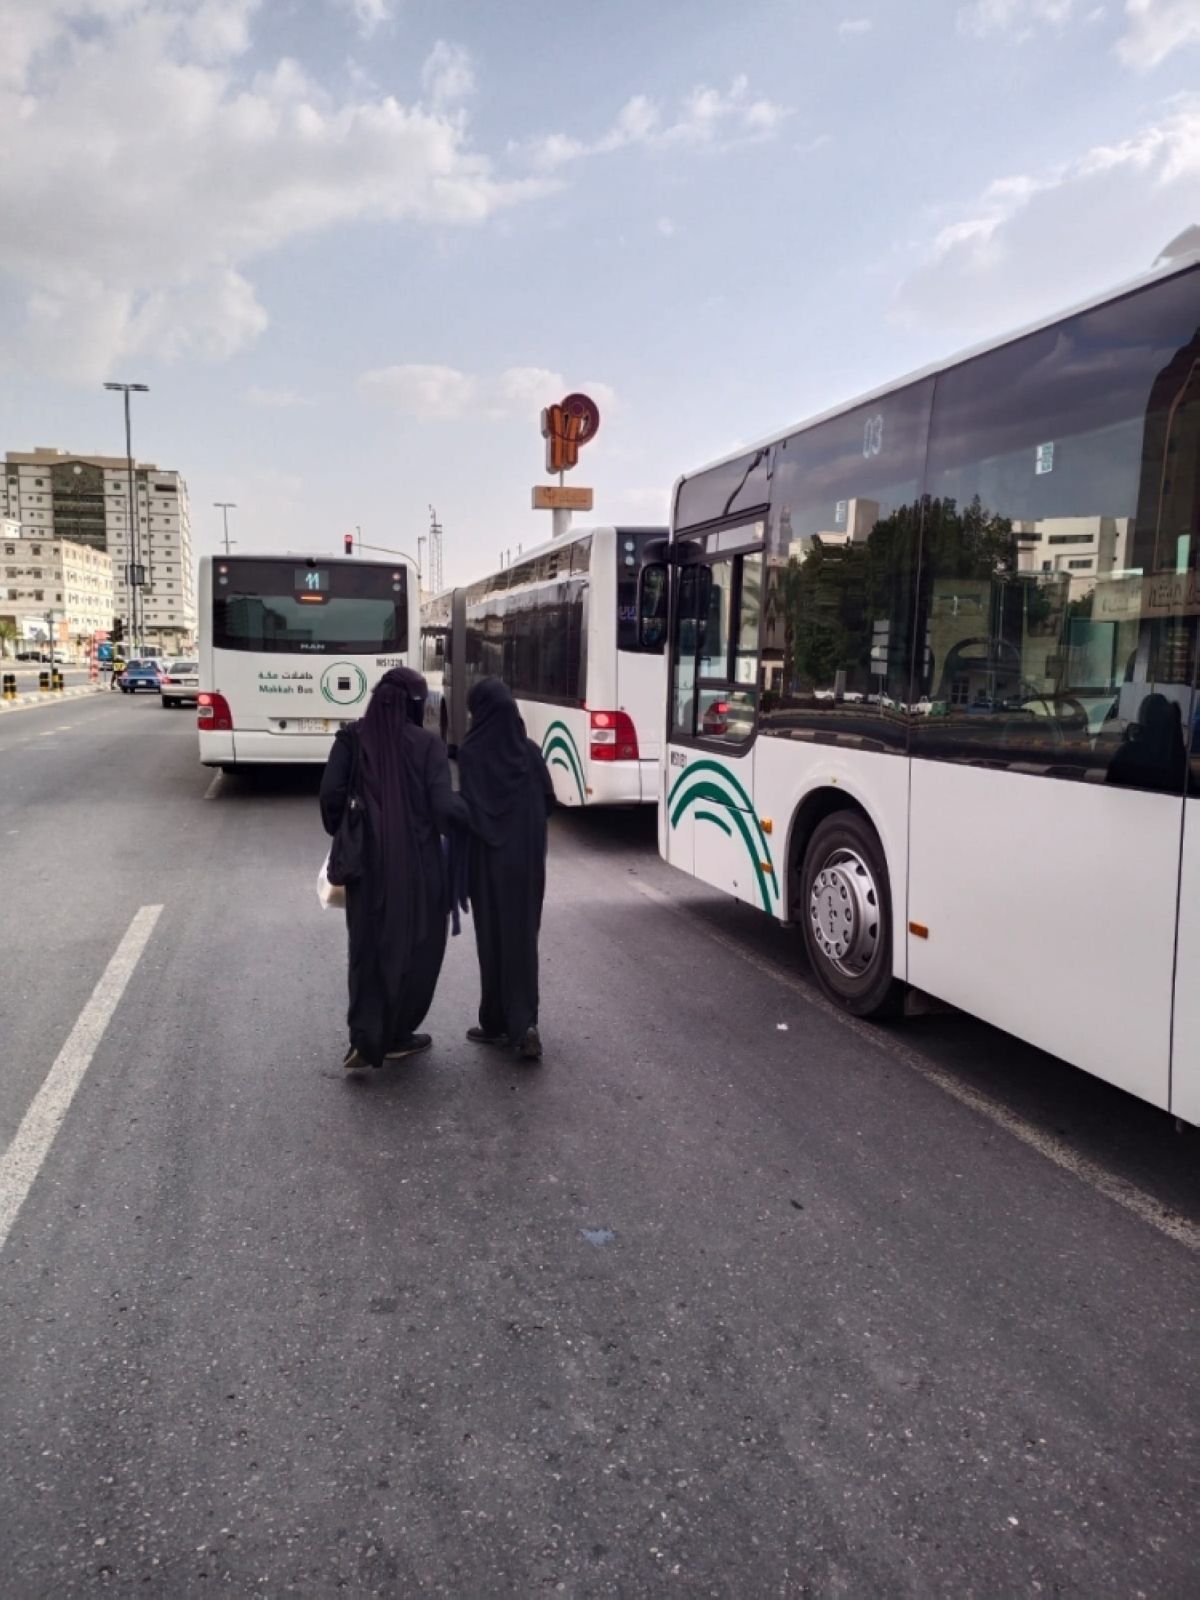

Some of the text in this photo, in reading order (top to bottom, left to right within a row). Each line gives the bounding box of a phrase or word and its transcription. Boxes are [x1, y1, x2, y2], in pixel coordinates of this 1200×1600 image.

[862, 414, 883, 459] 03
[305, 572, 320, 590] 11
[259, 684, 313, 694] Makkah Bus
